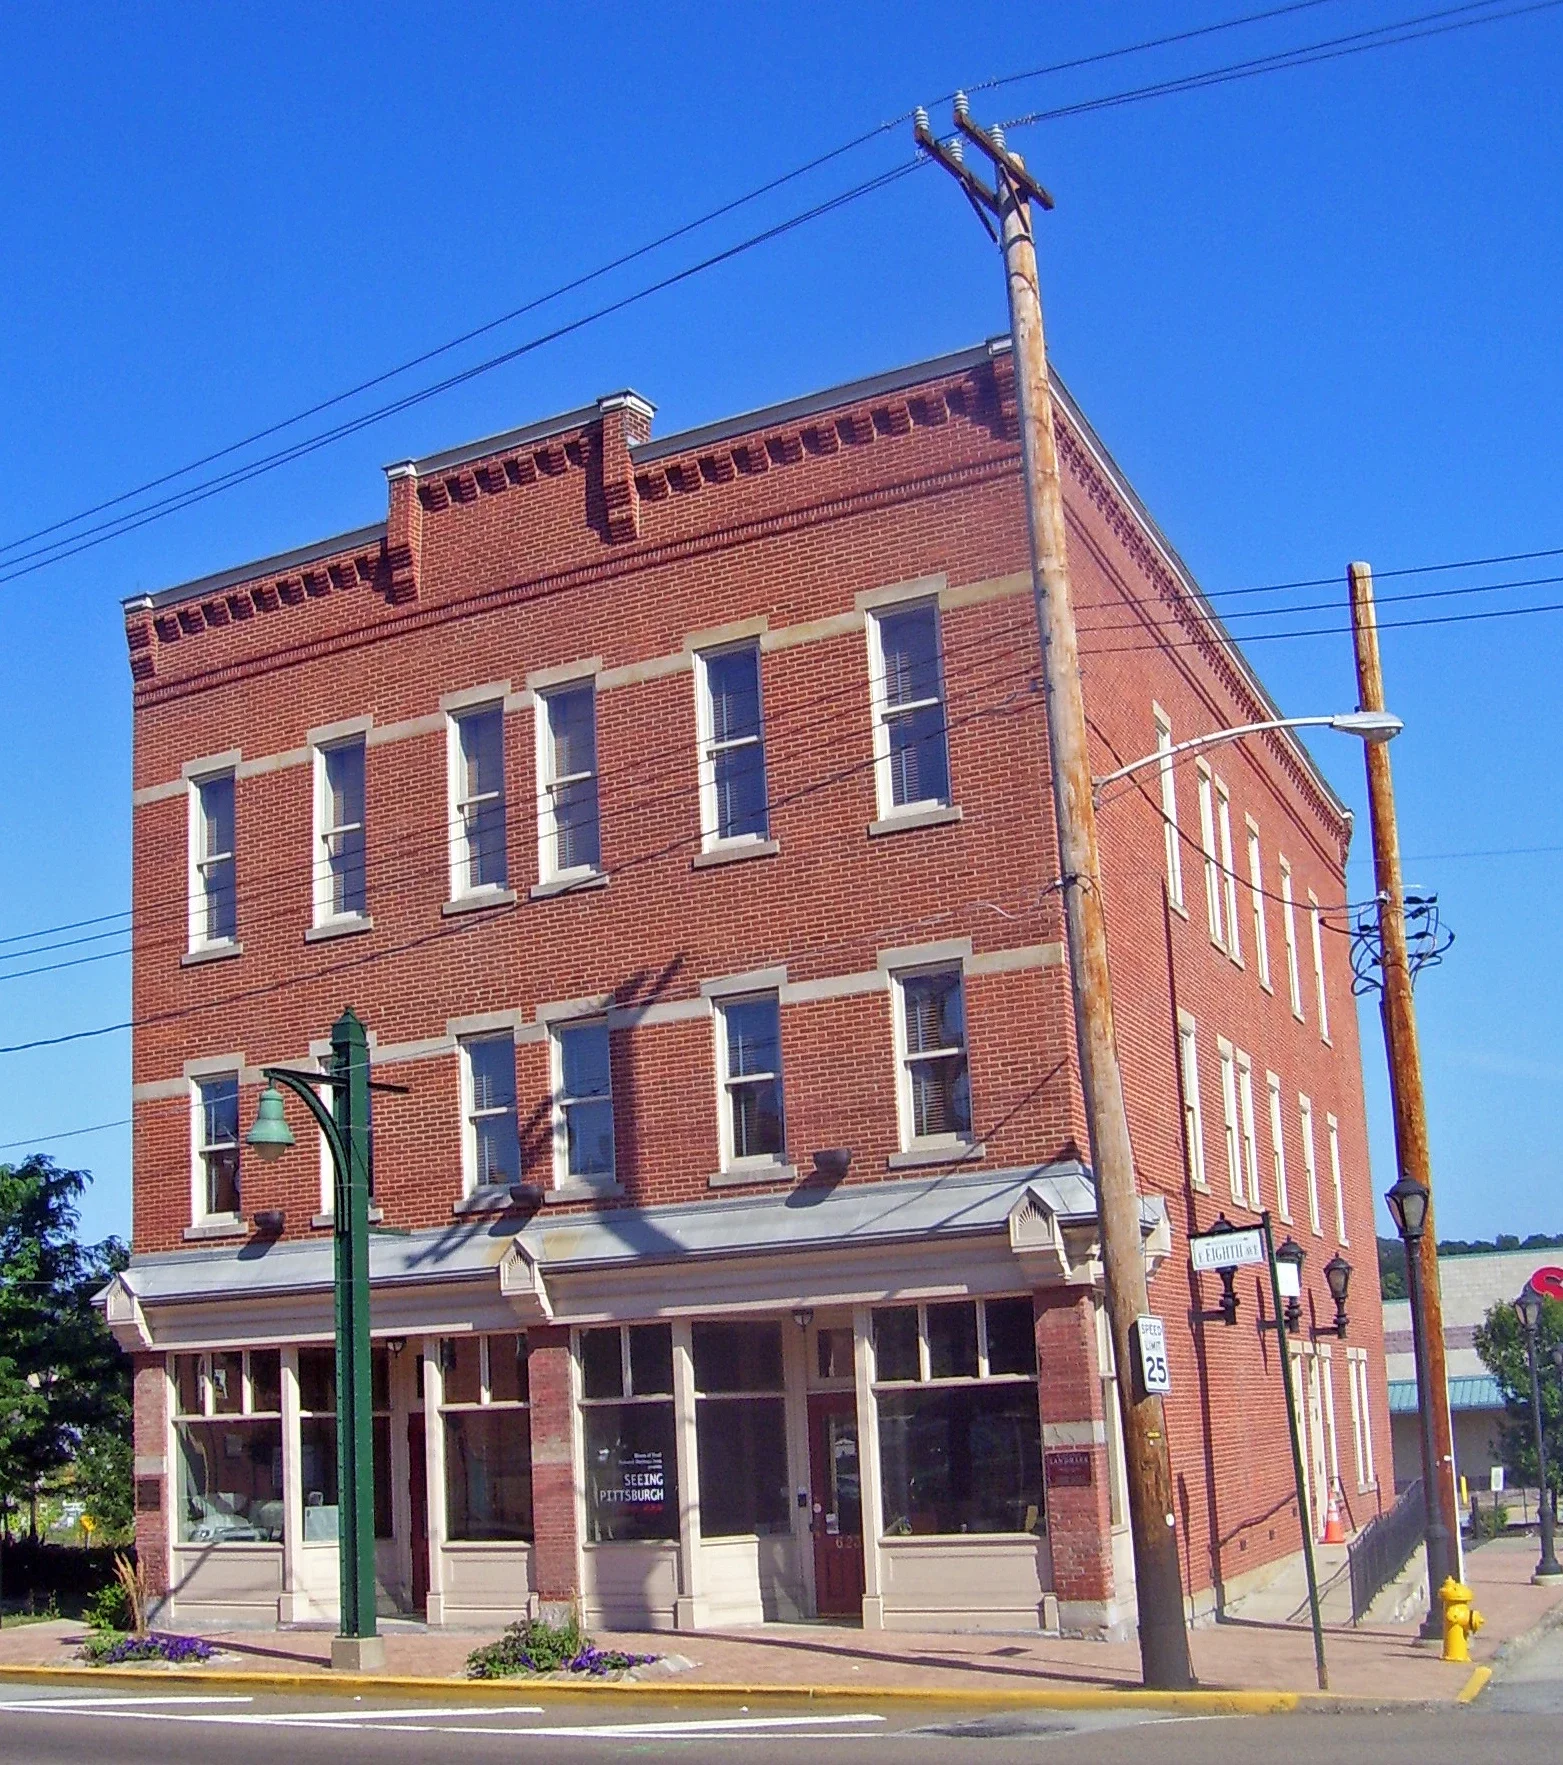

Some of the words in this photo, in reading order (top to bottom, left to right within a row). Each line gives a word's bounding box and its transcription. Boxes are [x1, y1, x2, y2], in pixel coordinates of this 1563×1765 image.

[1205, 1243, 1243, 1262] EIGHTH
[1141, 1323, 1162, 1336] SPEED
[1145, 1340, 1162, 1351] LIMIT
[1145, 1355, 1167, 1384] 25
[624, 1473, 664, 1486] SEEING
[600, 1488, 664, 1501] PITTSBURGH
